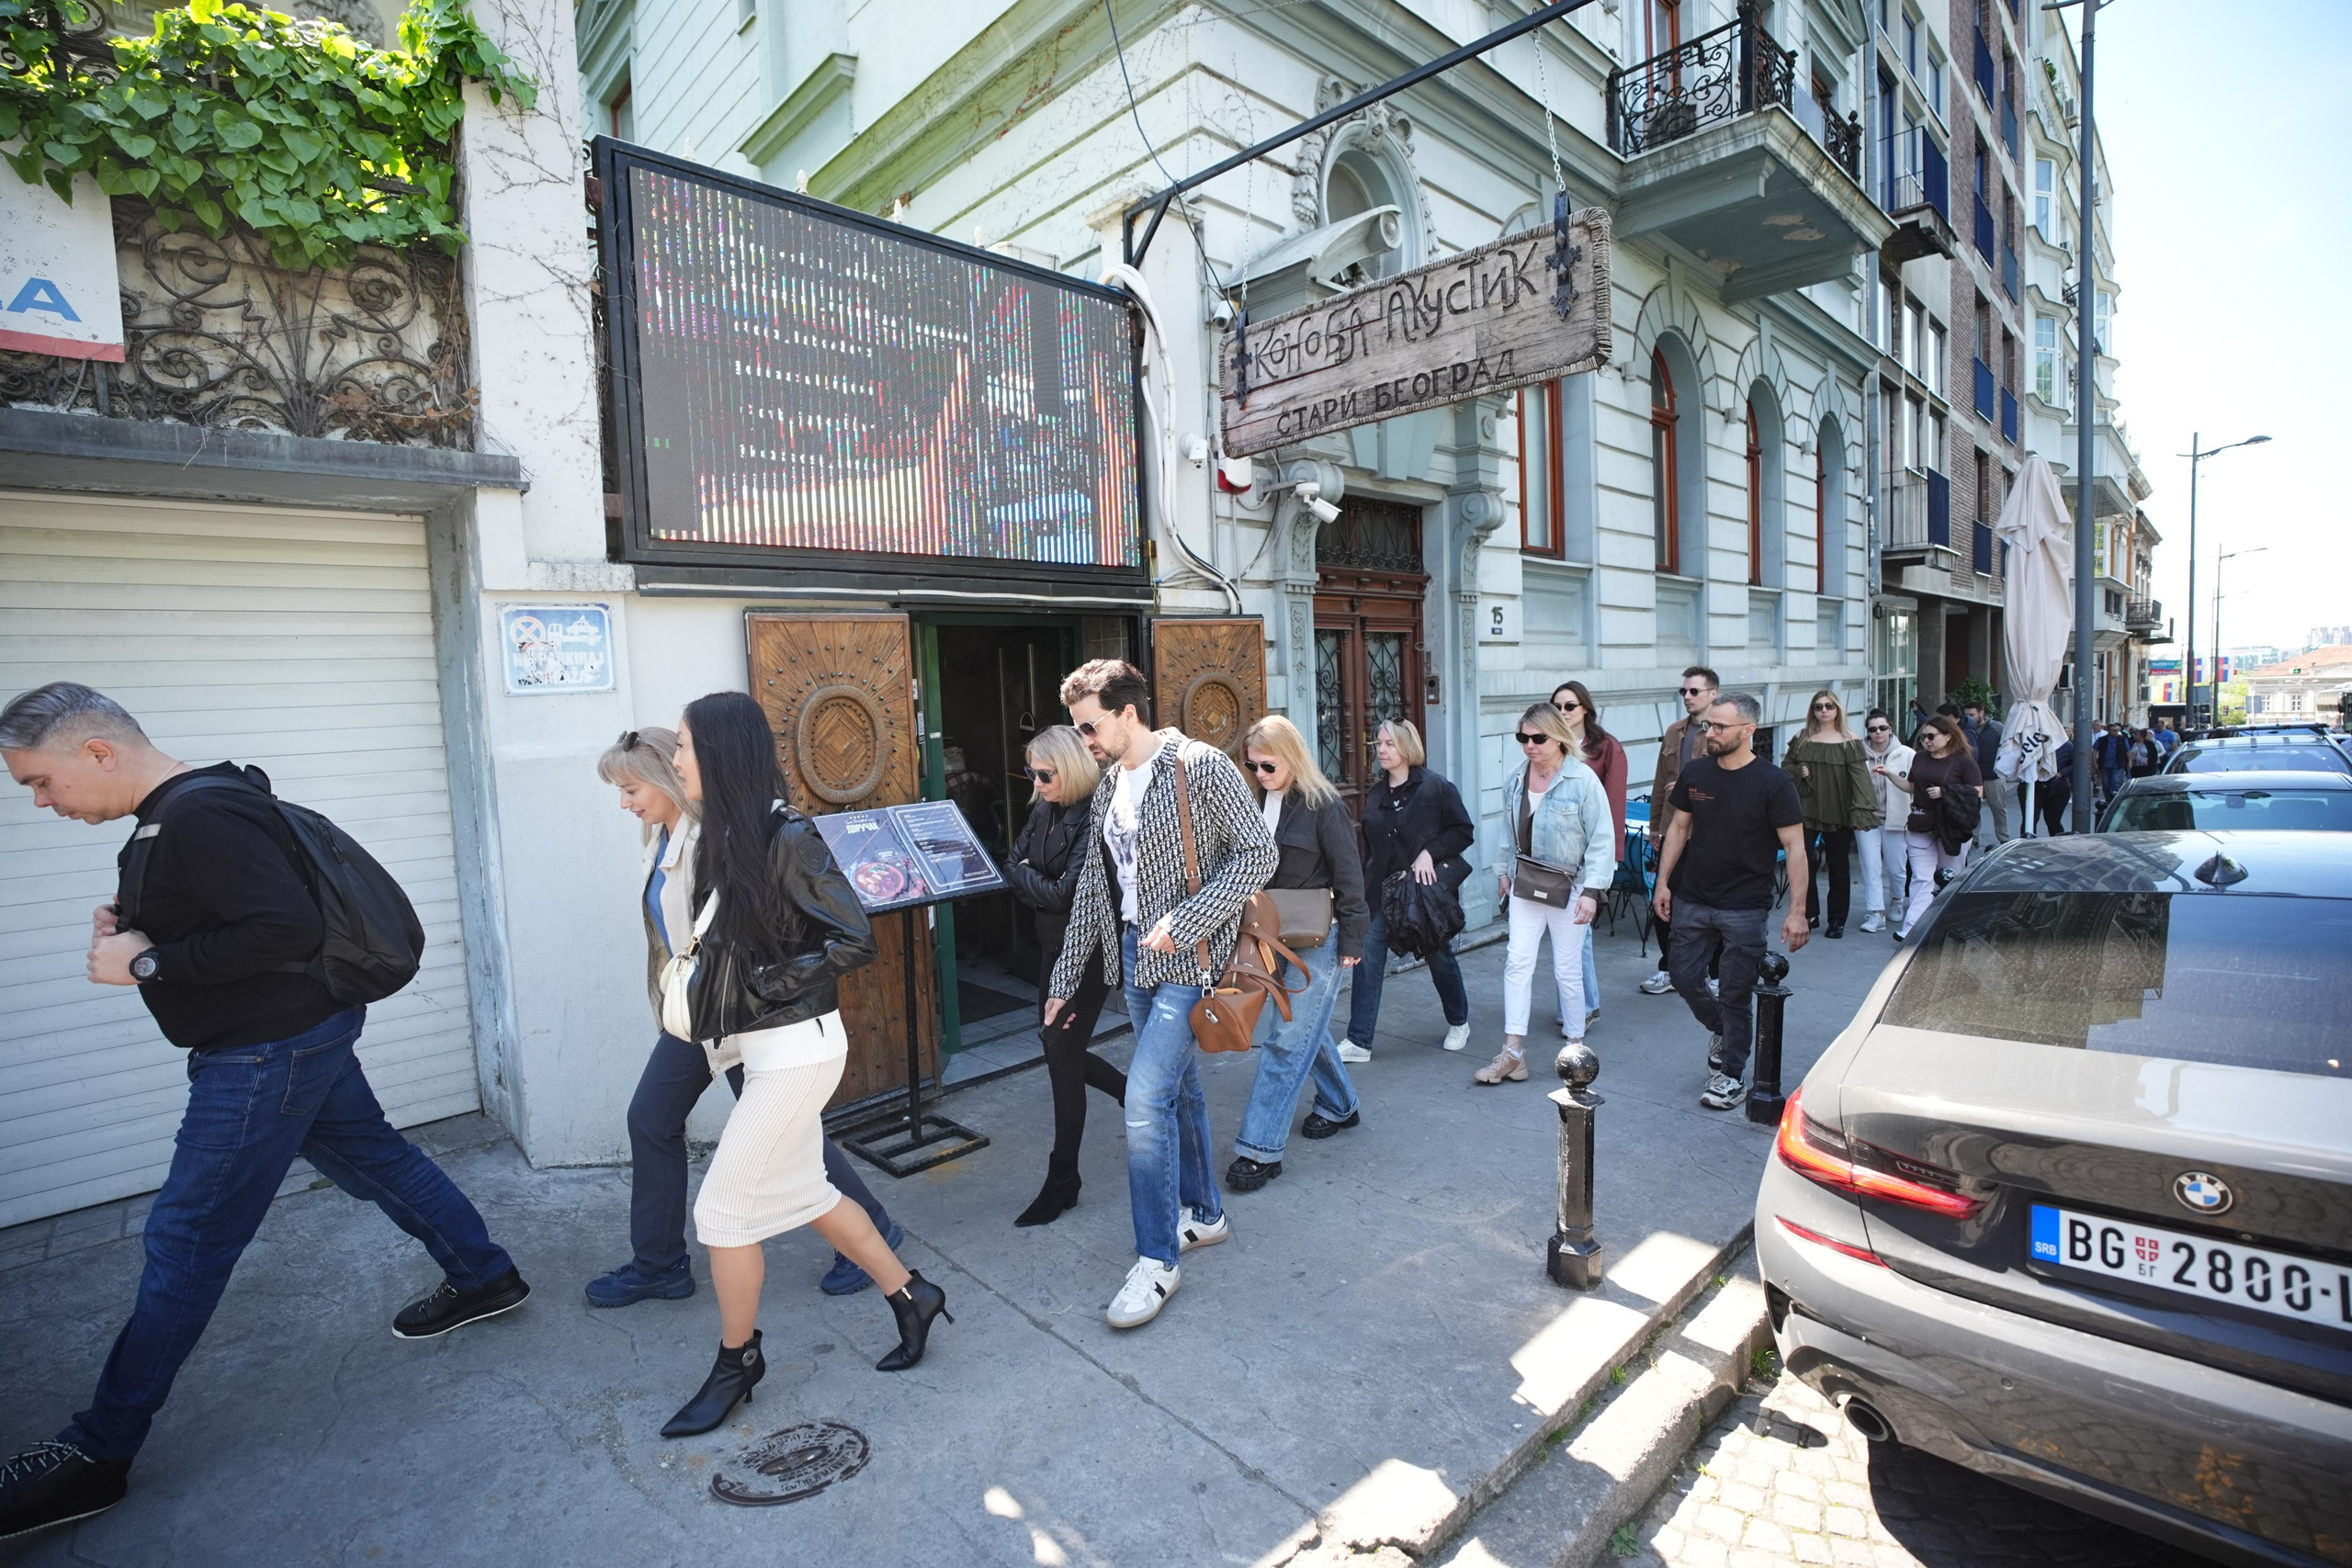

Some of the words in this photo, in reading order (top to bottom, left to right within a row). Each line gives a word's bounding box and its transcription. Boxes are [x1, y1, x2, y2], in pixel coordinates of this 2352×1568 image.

[0, 277, 82, 323] A
[1254, 305, 1369, 379] КОНОБА
[1385, 242, 1538, 344] АКУСТИК
[1277, 390, 1357, 436] СТАРИ
[1375, 348, 1515, 410] БЕОГРАД
[1491, 606, 1503, 625] 15
[846, 821, 879, 834] ДОРУЧАК
[2179, 1174, 2227, 1191] BMW
[2035, 1240, 2057, 1257] SRB
[2069, 1219, 2125, 1269] BG
[2139, 1263, 2158, 1279] БГ
